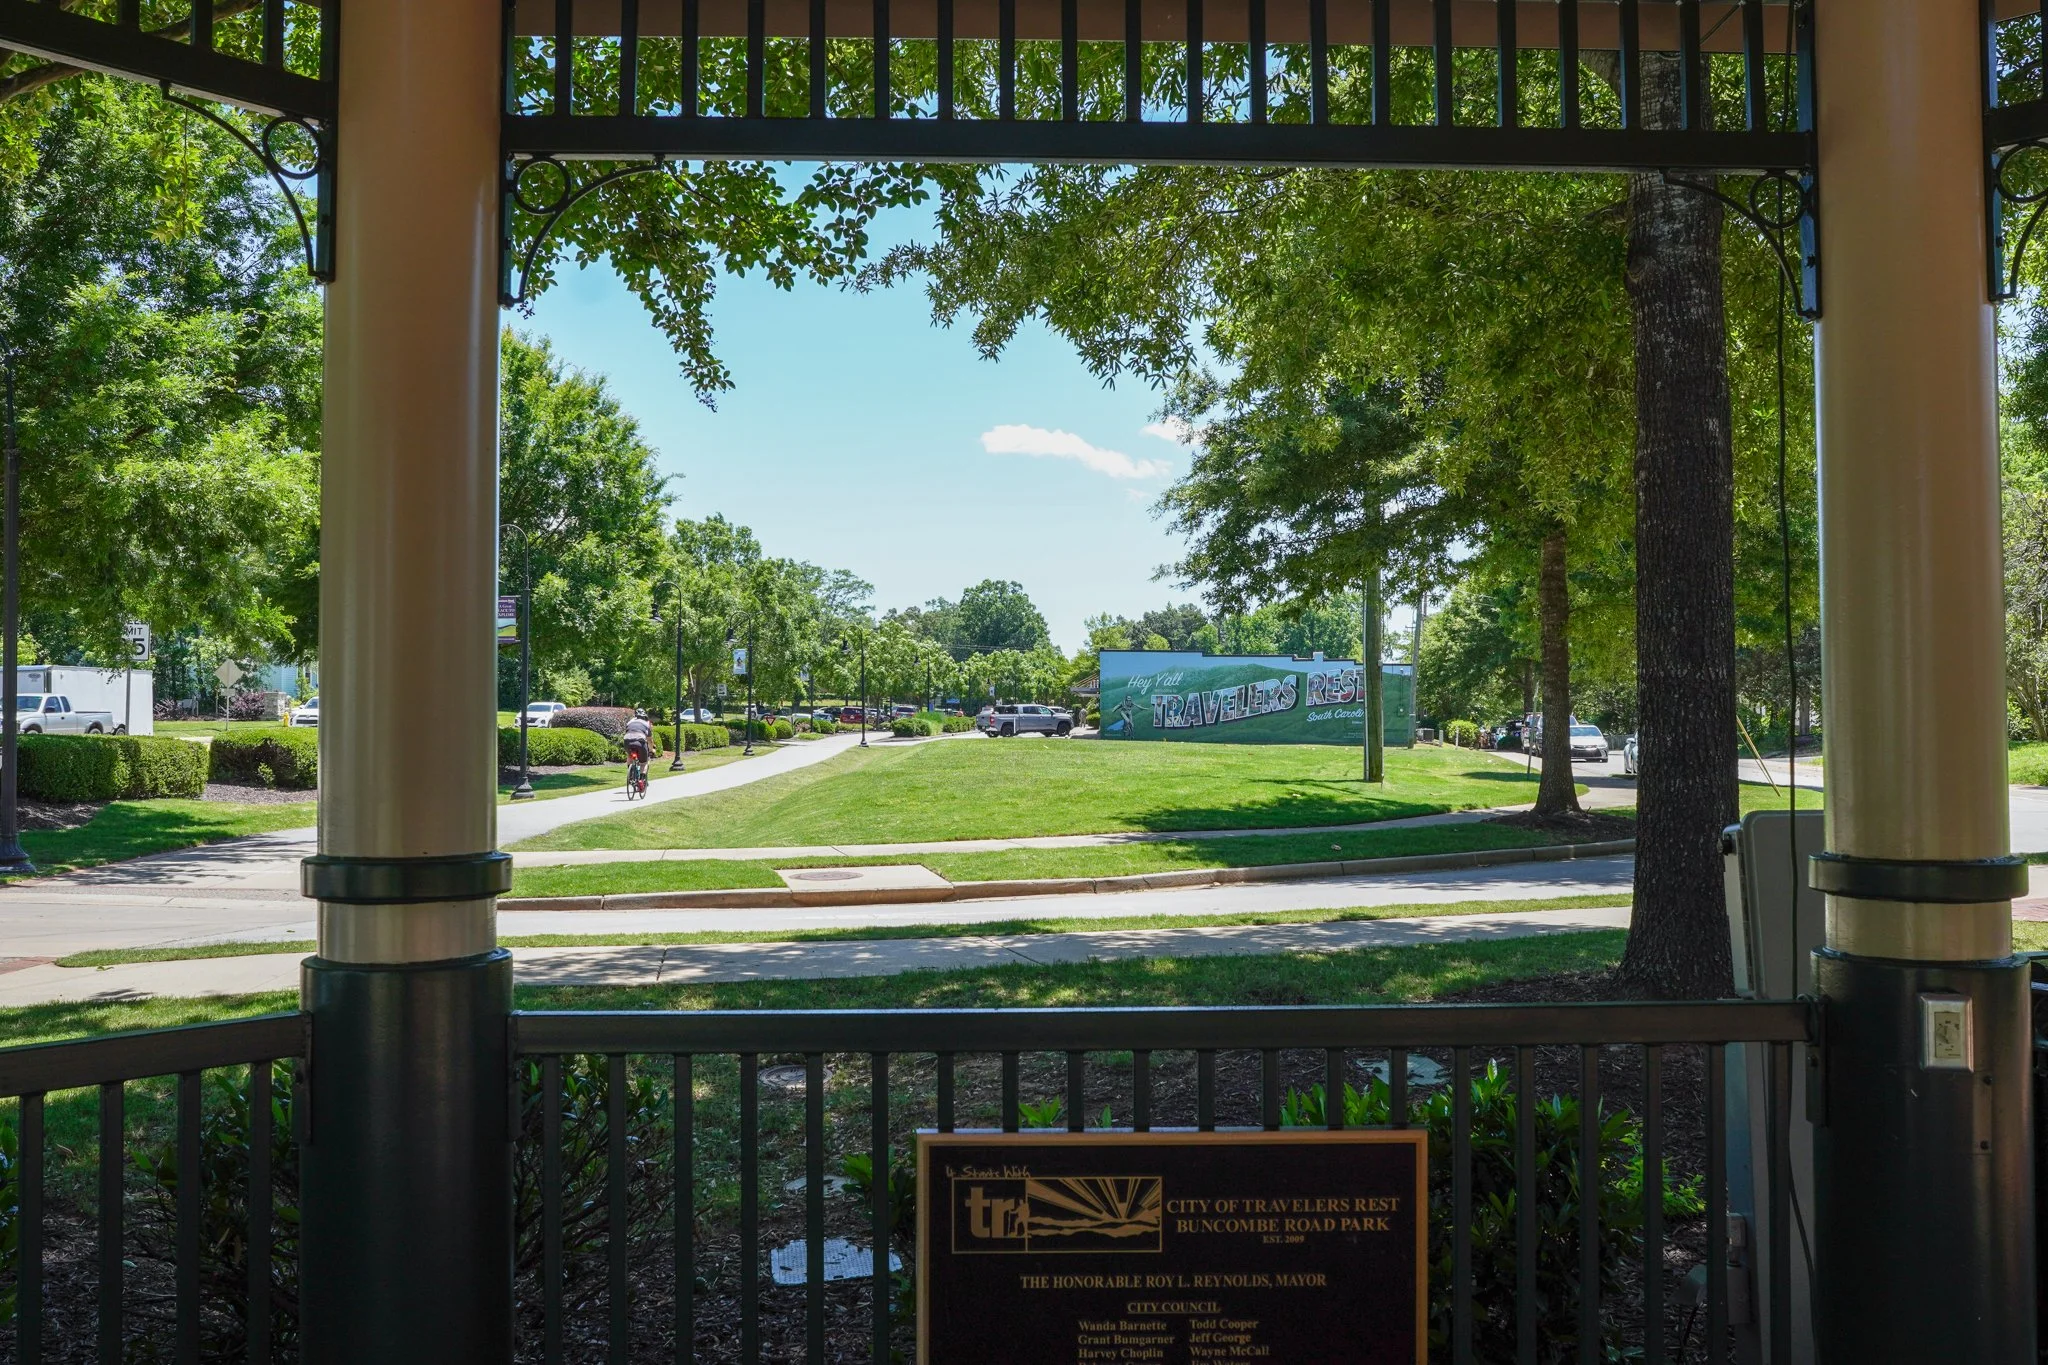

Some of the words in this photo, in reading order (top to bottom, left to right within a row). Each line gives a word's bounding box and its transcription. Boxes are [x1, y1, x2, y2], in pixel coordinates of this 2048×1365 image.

[1127, 674, 1152, 695] Hey
[1155, 671, 1184, 687] Y'all
[1151, 674, 1297, 727] TRAVELERS
[1306, 709, 1333, 722] South
[1003, 1165, 1031, 1179] With
[1166, 1199, 1212, 1214] CITY
[1215, 1199, 1242, 1214] OF
[1244, 1198, 1350, 1213] TRAVELERS
[1354, 1197, 1400, 1212] REST
[1176, 1218, 1280, 1233] BUNCOMBE
[1284, 1217, 1336, 1232] ROAD
[1340, 1216, 1391, 1231] PARK
[1262, 1235, 1283, 1244] EST.
[1285, 1234, 1305, 1243] 2009
[1020, 1275, 1049, 1289] THE
[1053, 1275, 1142, 1289] HONORABLE
[1146, 1275, 1175, 1288] ROY
[1178, 1275, 1191, 1288] L.
[1193, 1274, 1273, 1289] REYNOLDS,
[1276, 1273, 1327, 1287] MAYOR
[1127, 1302, 1158, 1313] CITY
[1161, 1302, 1221, 1313] COUNCIL
[1078, 1320, 1116, 1331] Wanda
[1119, 1320, 1167, 1331] Barnette
[1189, 1319, 1217, 1330] Todd
[1219, 1319, 1259, 1331] Cooper
[1077, 1334, 1111, 1345] Grant
[1113, 1334, 1176, 1347] Bumgarner
[1189, 1333, 1212, 1344] Jeff
[1212, 1333, 1252, 1345] George
[1078, 1348, 1118, 1361] Harvey
[1120, 1348, 1164, 1361] Choplin
[1190, 1346, 1227, 1359] Wayne
[1229, 1345, 1270, 1357] McCall
